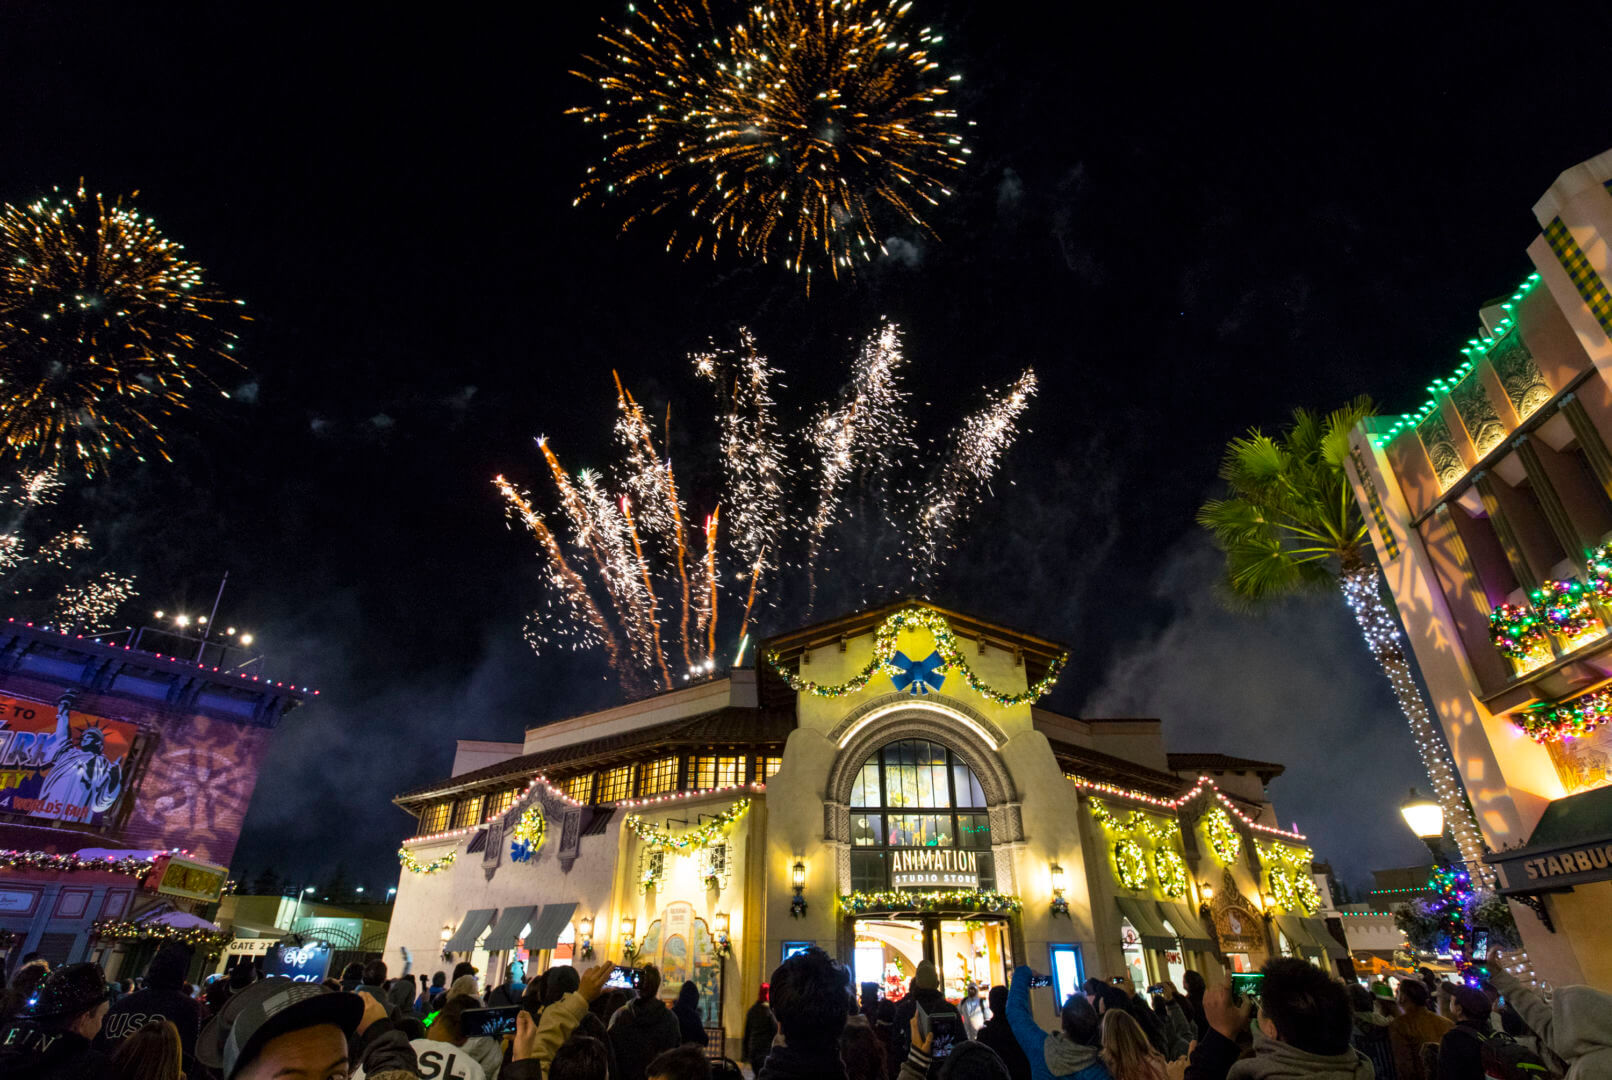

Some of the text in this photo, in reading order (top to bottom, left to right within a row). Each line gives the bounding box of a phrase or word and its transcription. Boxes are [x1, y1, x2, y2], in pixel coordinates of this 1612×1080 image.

[13, 706, 36, 720] TO
[892, 849, 977, 873] ANIMATION
[895, 873, 977, 883] STUDIO STORE
[230, 941, 256, 950] GATE
[105, 1012, 167, 1039] US
